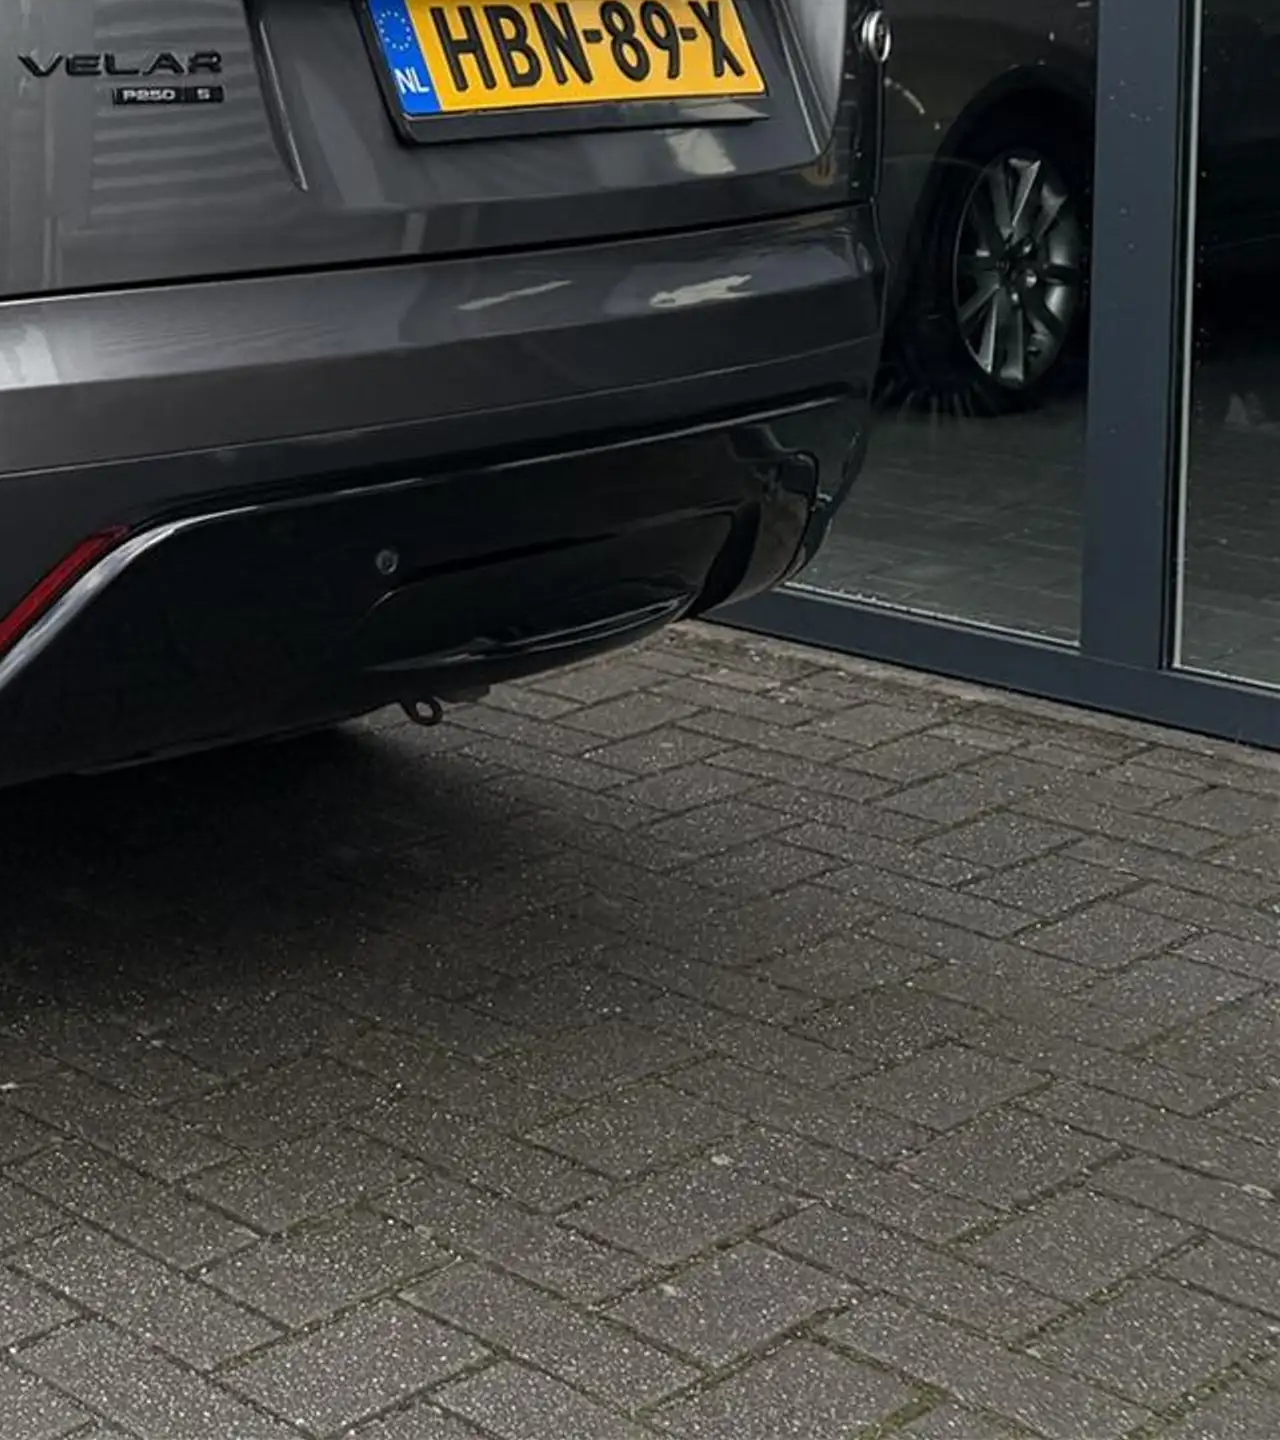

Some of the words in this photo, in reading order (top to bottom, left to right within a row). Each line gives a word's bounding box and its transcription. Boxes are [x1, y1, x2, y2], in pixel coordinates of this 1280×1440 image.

[429, 0, 746, 92] HBN-89-X
[17, 51, 223, 77] VELAR
[395, 68, 430, 95] NL
